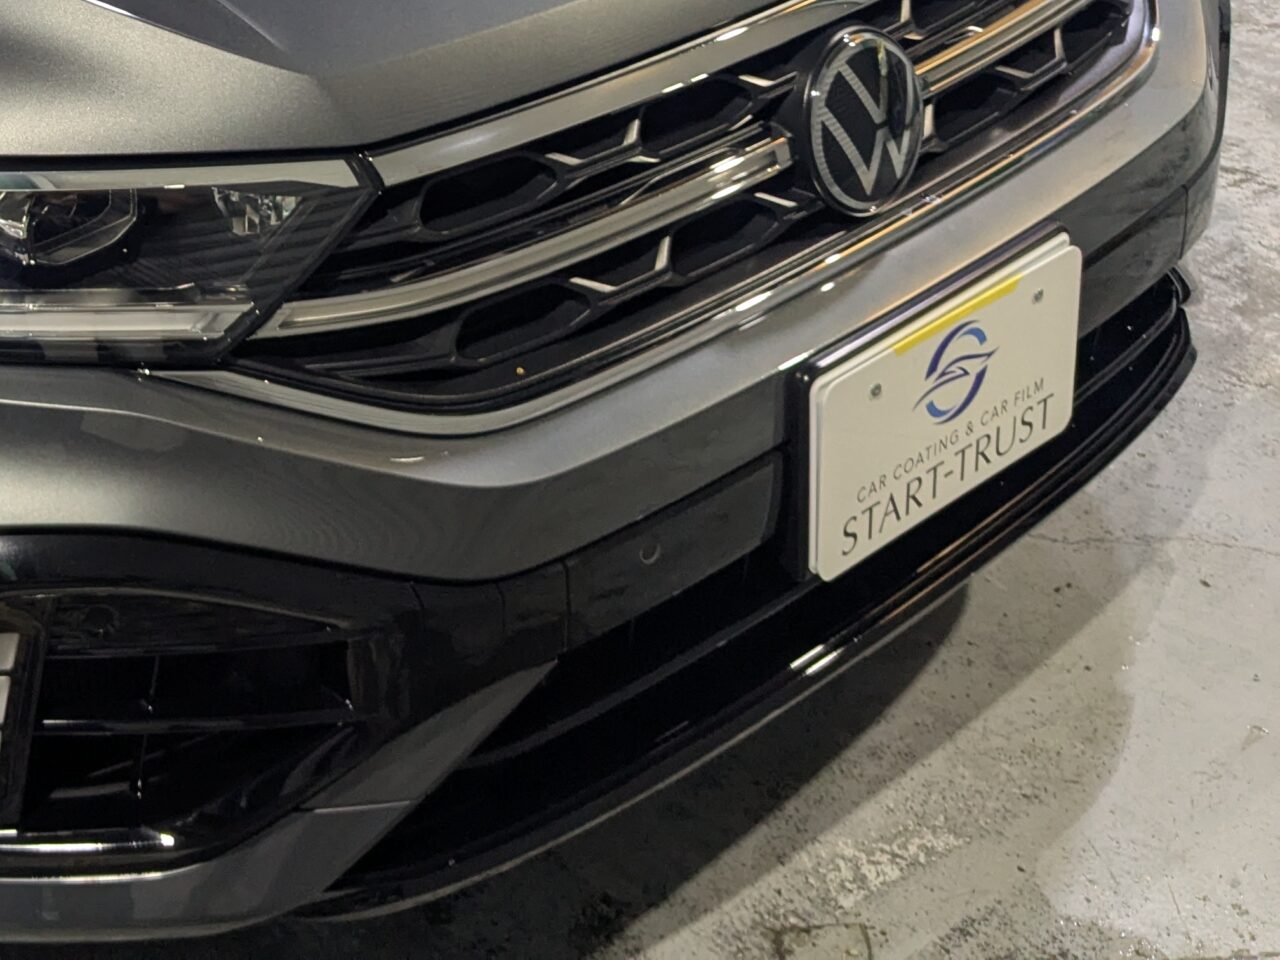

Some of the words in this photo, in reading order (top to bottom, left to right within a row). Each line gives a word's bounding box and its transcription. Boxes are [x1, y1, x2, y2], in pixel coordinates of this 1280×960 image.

[841, 393, 1055, 556] START-TRUST
[856, 473, 887, 503] CAR
[892, 429, 959, 481] COATING
[965, 421, 974, 436] &
[980, 399, 1008, 427] CAR
[1014, 377, 1045, 407] FILM
